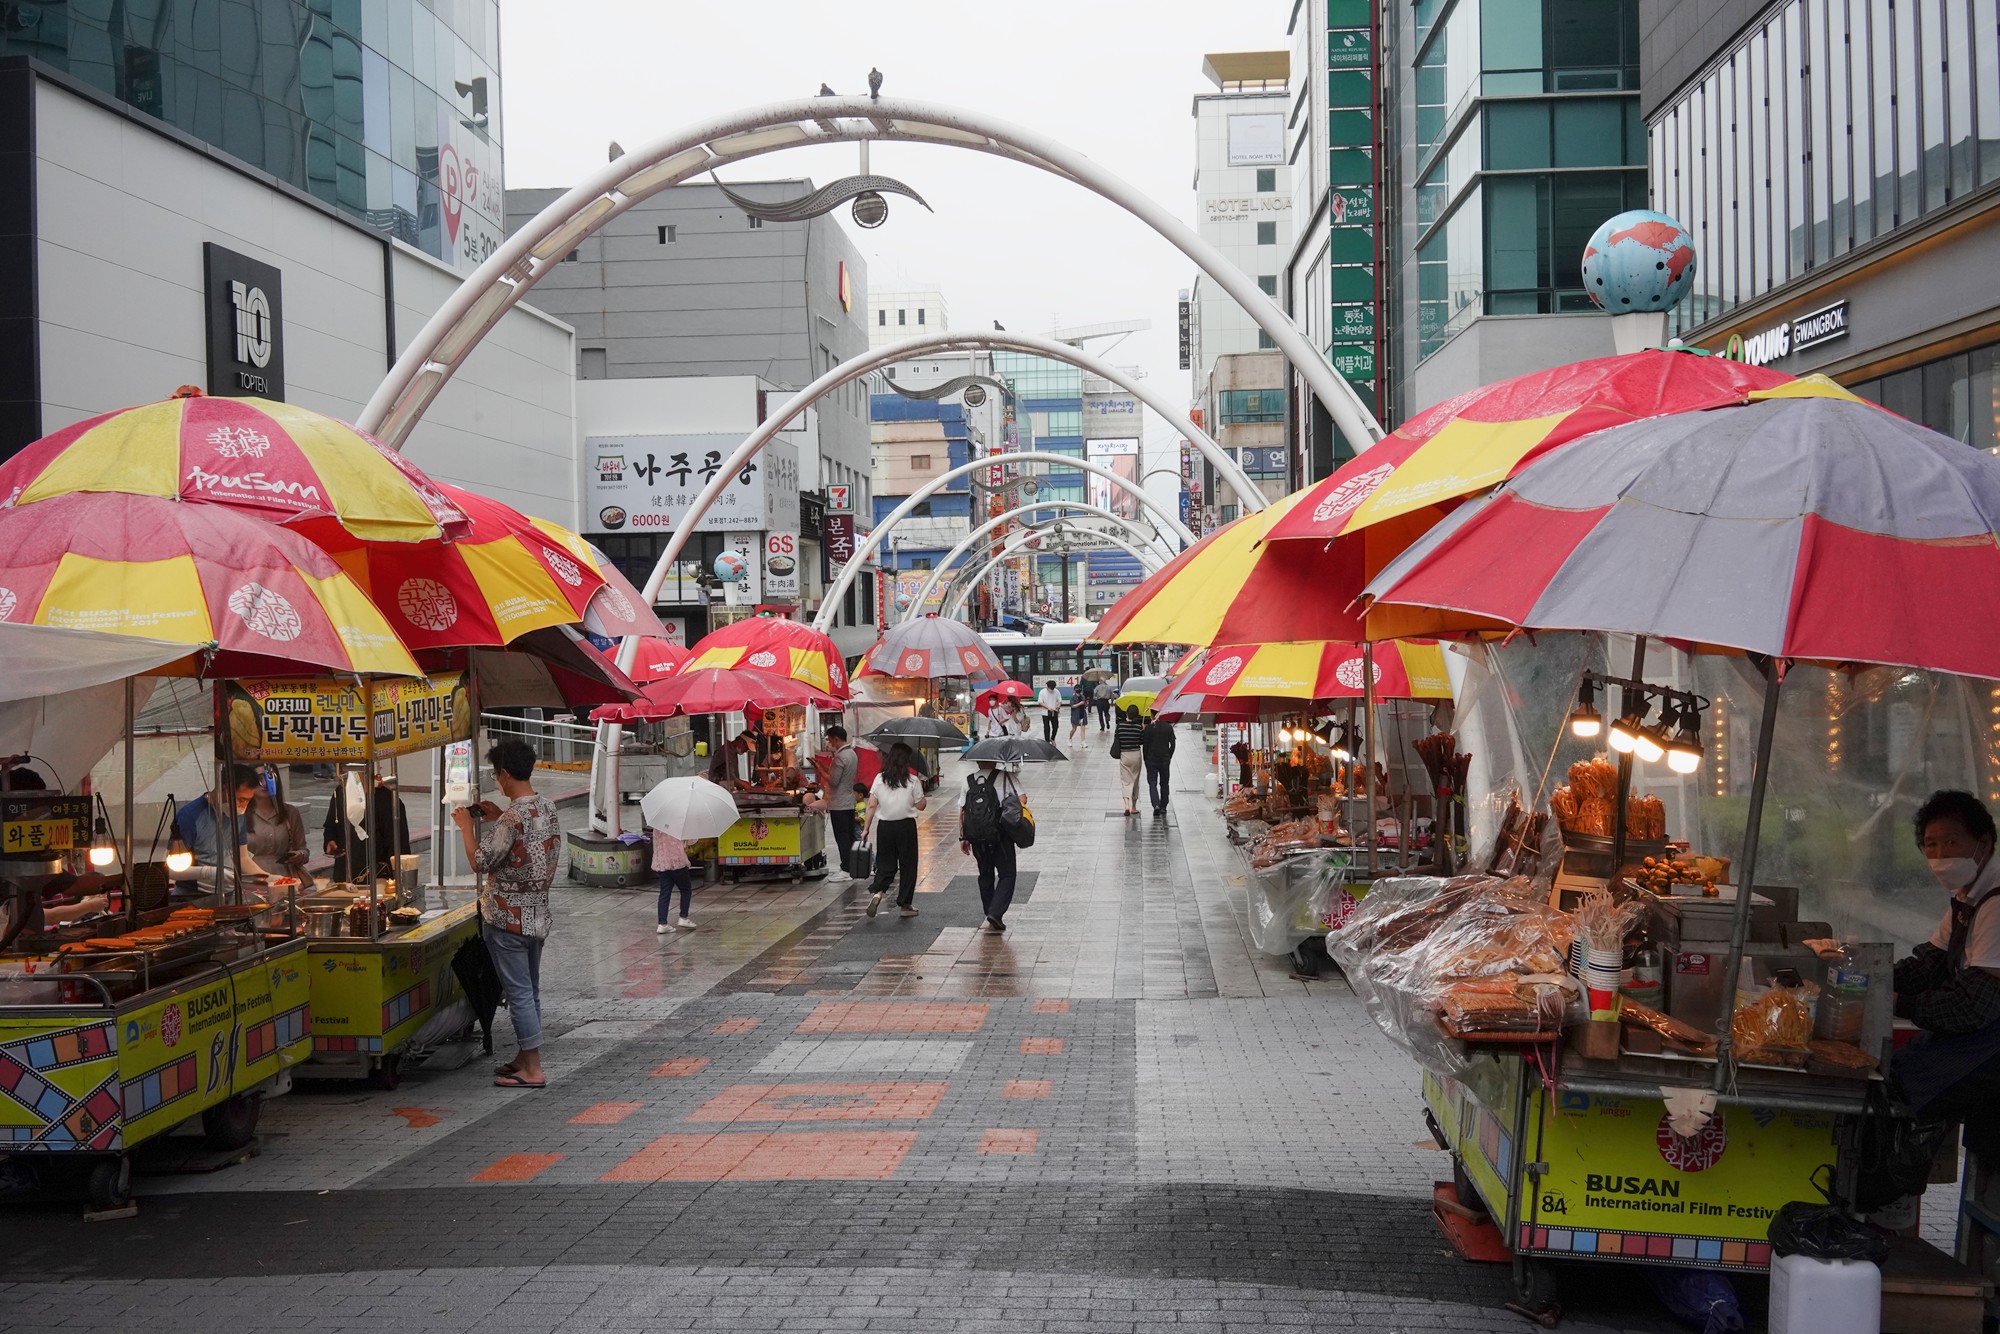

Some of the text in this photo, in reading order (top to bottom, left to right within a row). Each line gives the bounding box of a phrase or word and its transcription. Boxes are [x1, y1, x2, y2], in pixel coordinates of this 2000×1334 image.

[1206, 199, 1259, 212] HOTEL
[1347, 207, 1372, 218] 노래방
[231, 279, 272, 369] 10
[1793, 307, 1844, 344] GWANGBOK
[1744, 322, 1790, 366] YOUNG
[1335, 355, 1373, 374] 애플치과
[240, 372, 268, 394] TOPTEN
[1090, 399, 1136, 415] 자갈치시장
[211, 489, 321, 510] International Film Festival
[632, 514, 670, 526] 6000원
[768, 534, 794, 555] 6$
[769, 579, 795, 588] 牛肉湯
[48, 608, 197, 624] International Film Festival
[78, 608, 129, 618] BUSAN
[131, 619, 159, 627] 2019
[270, 682, 318, 694] 남포동명물
[266, 699, 309, 713] 아저씨
[316, 693, 355, 713] 런닝맨
[374, 712, 395, 738] 아저씨
[396, 694, 453, 740] 납짝만두
[263, 715, 369, 743] 납짝만두
[187, 987, 229, 1019] BUSAN
[187, 1008, 232, 1036] International
[247, 991, 272, 1008] Festival
[315, 1015, 349, 1025] Festival
[1599, 1106, 1632, 1118] junggu
[1792, 1117, 1830, 1129] BUSAN
[1586, 1173, 1680, 1198] BUSAN
[1541, 1195, 1568, 1216] 84
[1585, 1194, 1779, 1220] International Film Festiv
